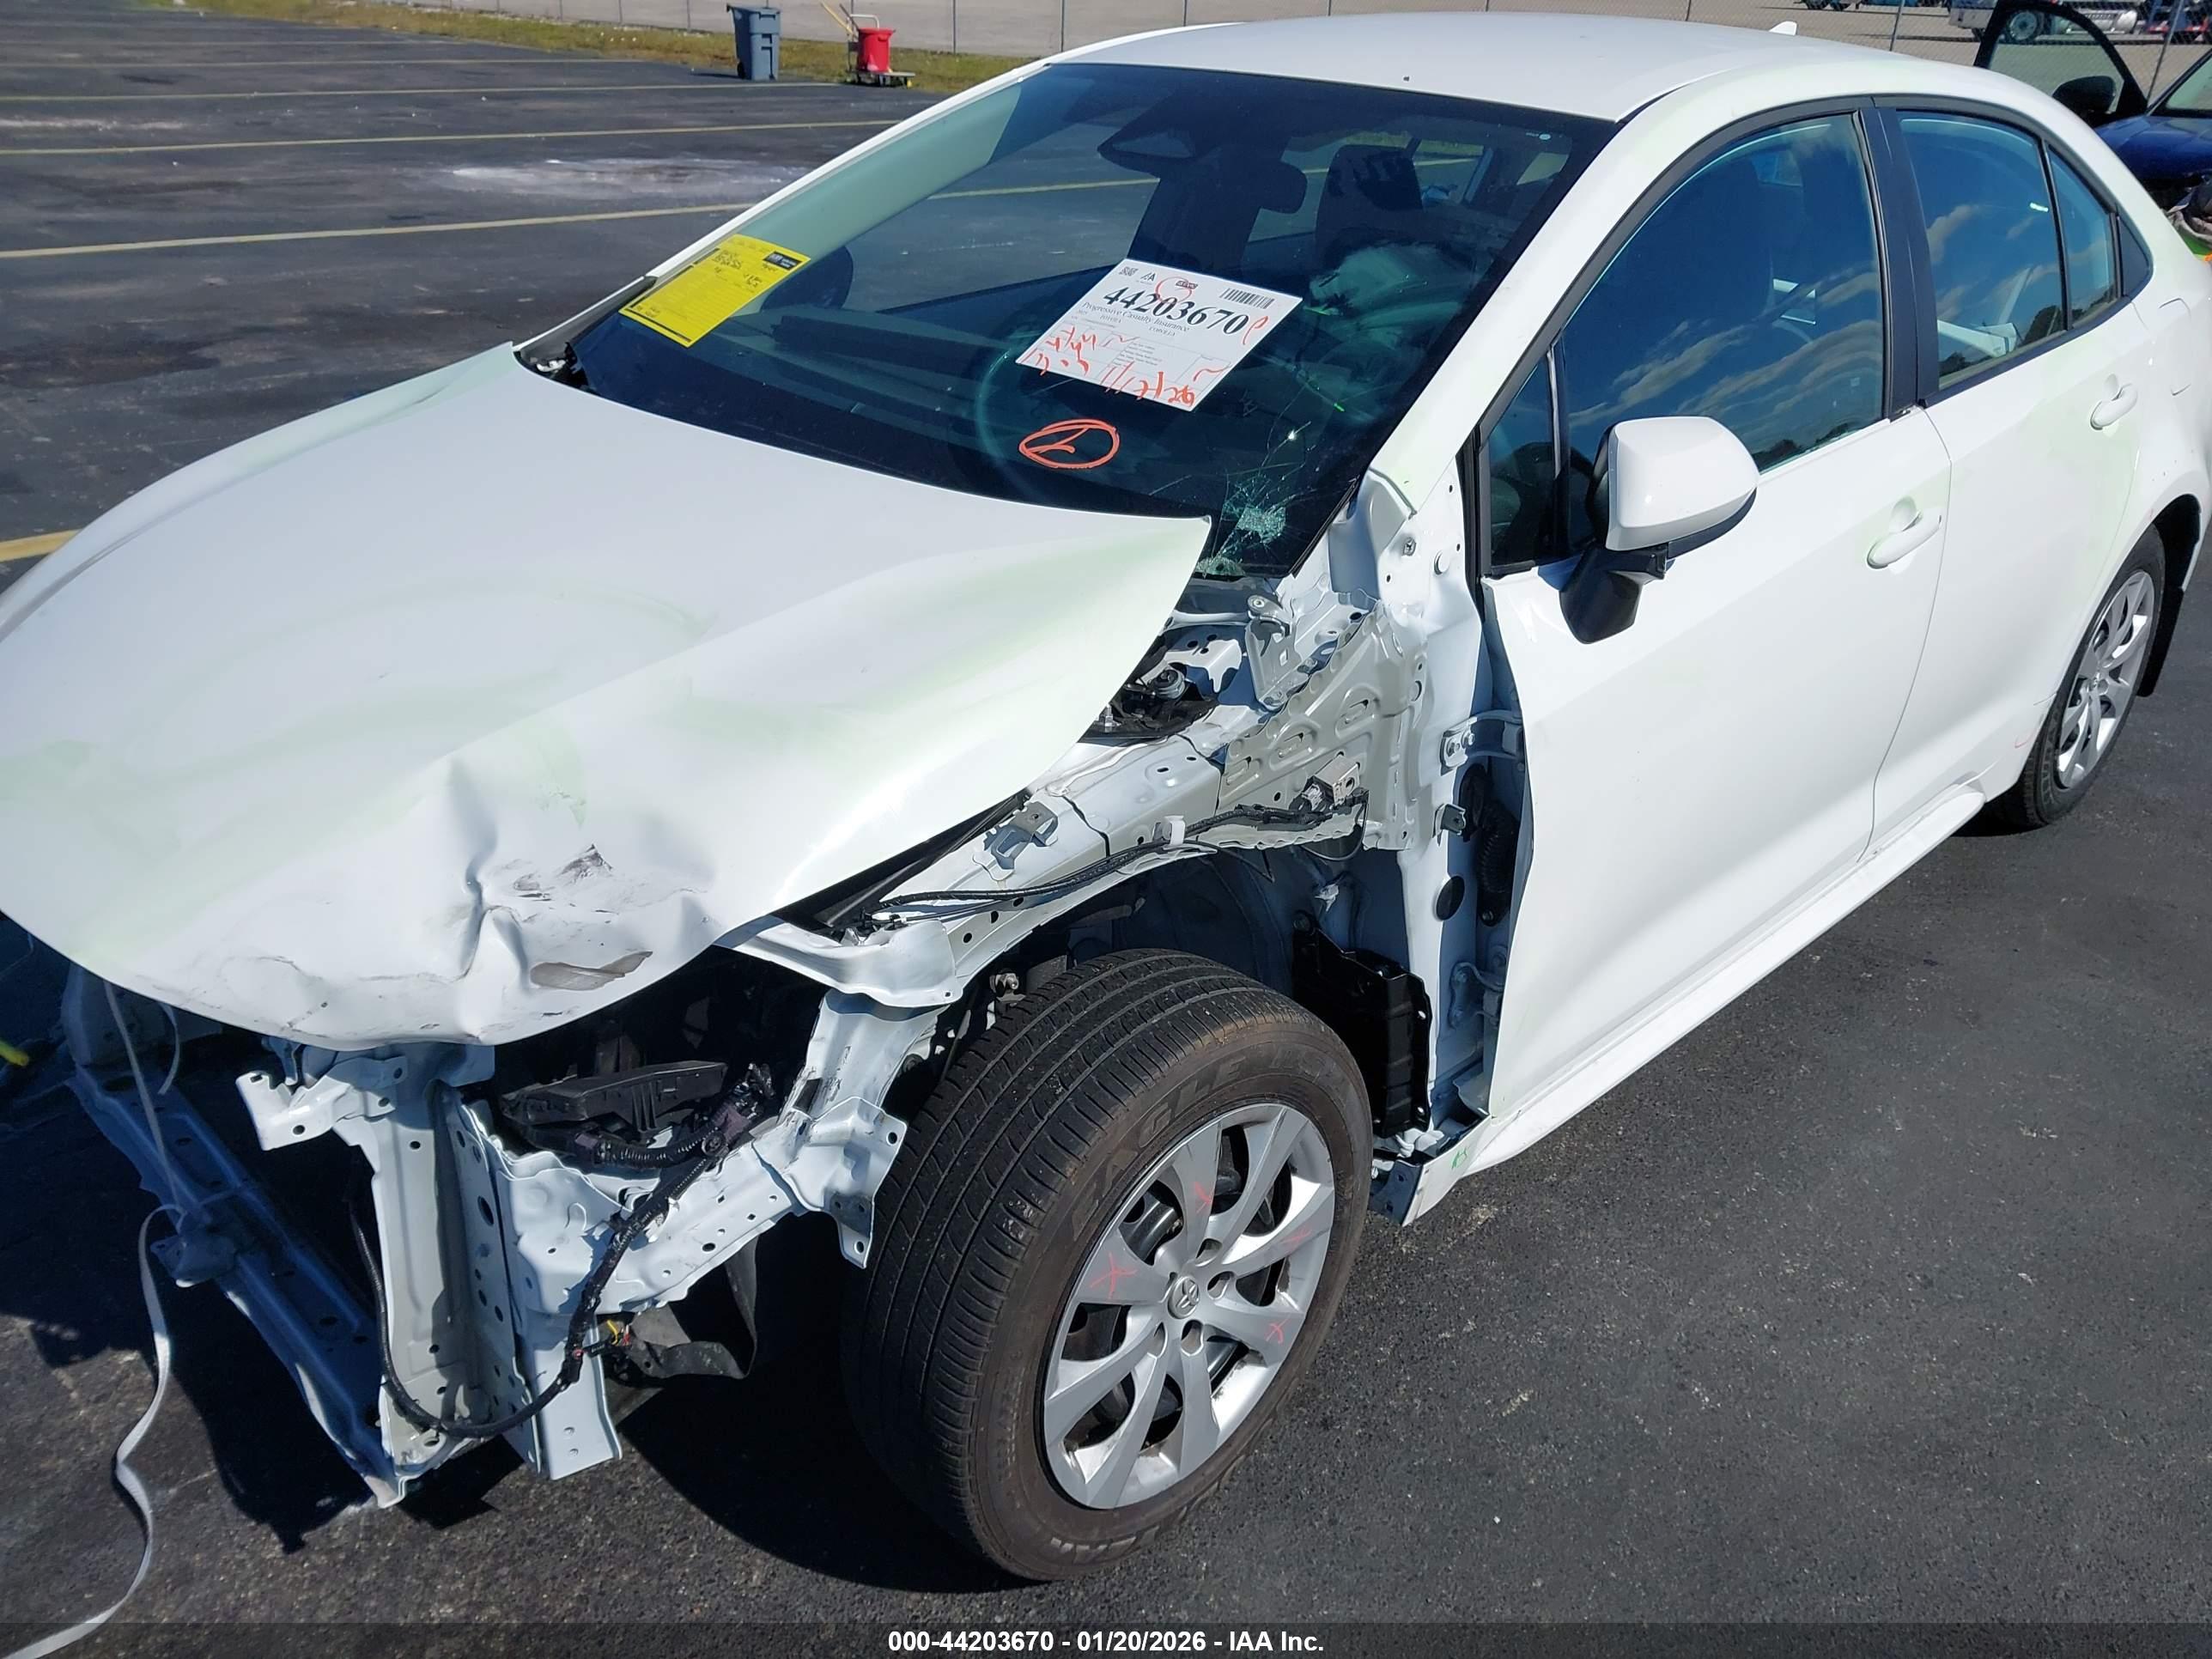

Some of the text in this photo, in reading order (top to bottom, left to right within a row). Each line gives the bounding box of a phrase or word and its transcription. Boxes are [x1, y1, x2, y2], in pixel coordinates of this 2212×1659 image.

[1082, 301, 1122, 315] Progressive
[1122, 310, 1152, 324] Casualty
[1153, 317, 1190, 332] Insurance
[1103, 287, 1249, 335] 44203670
